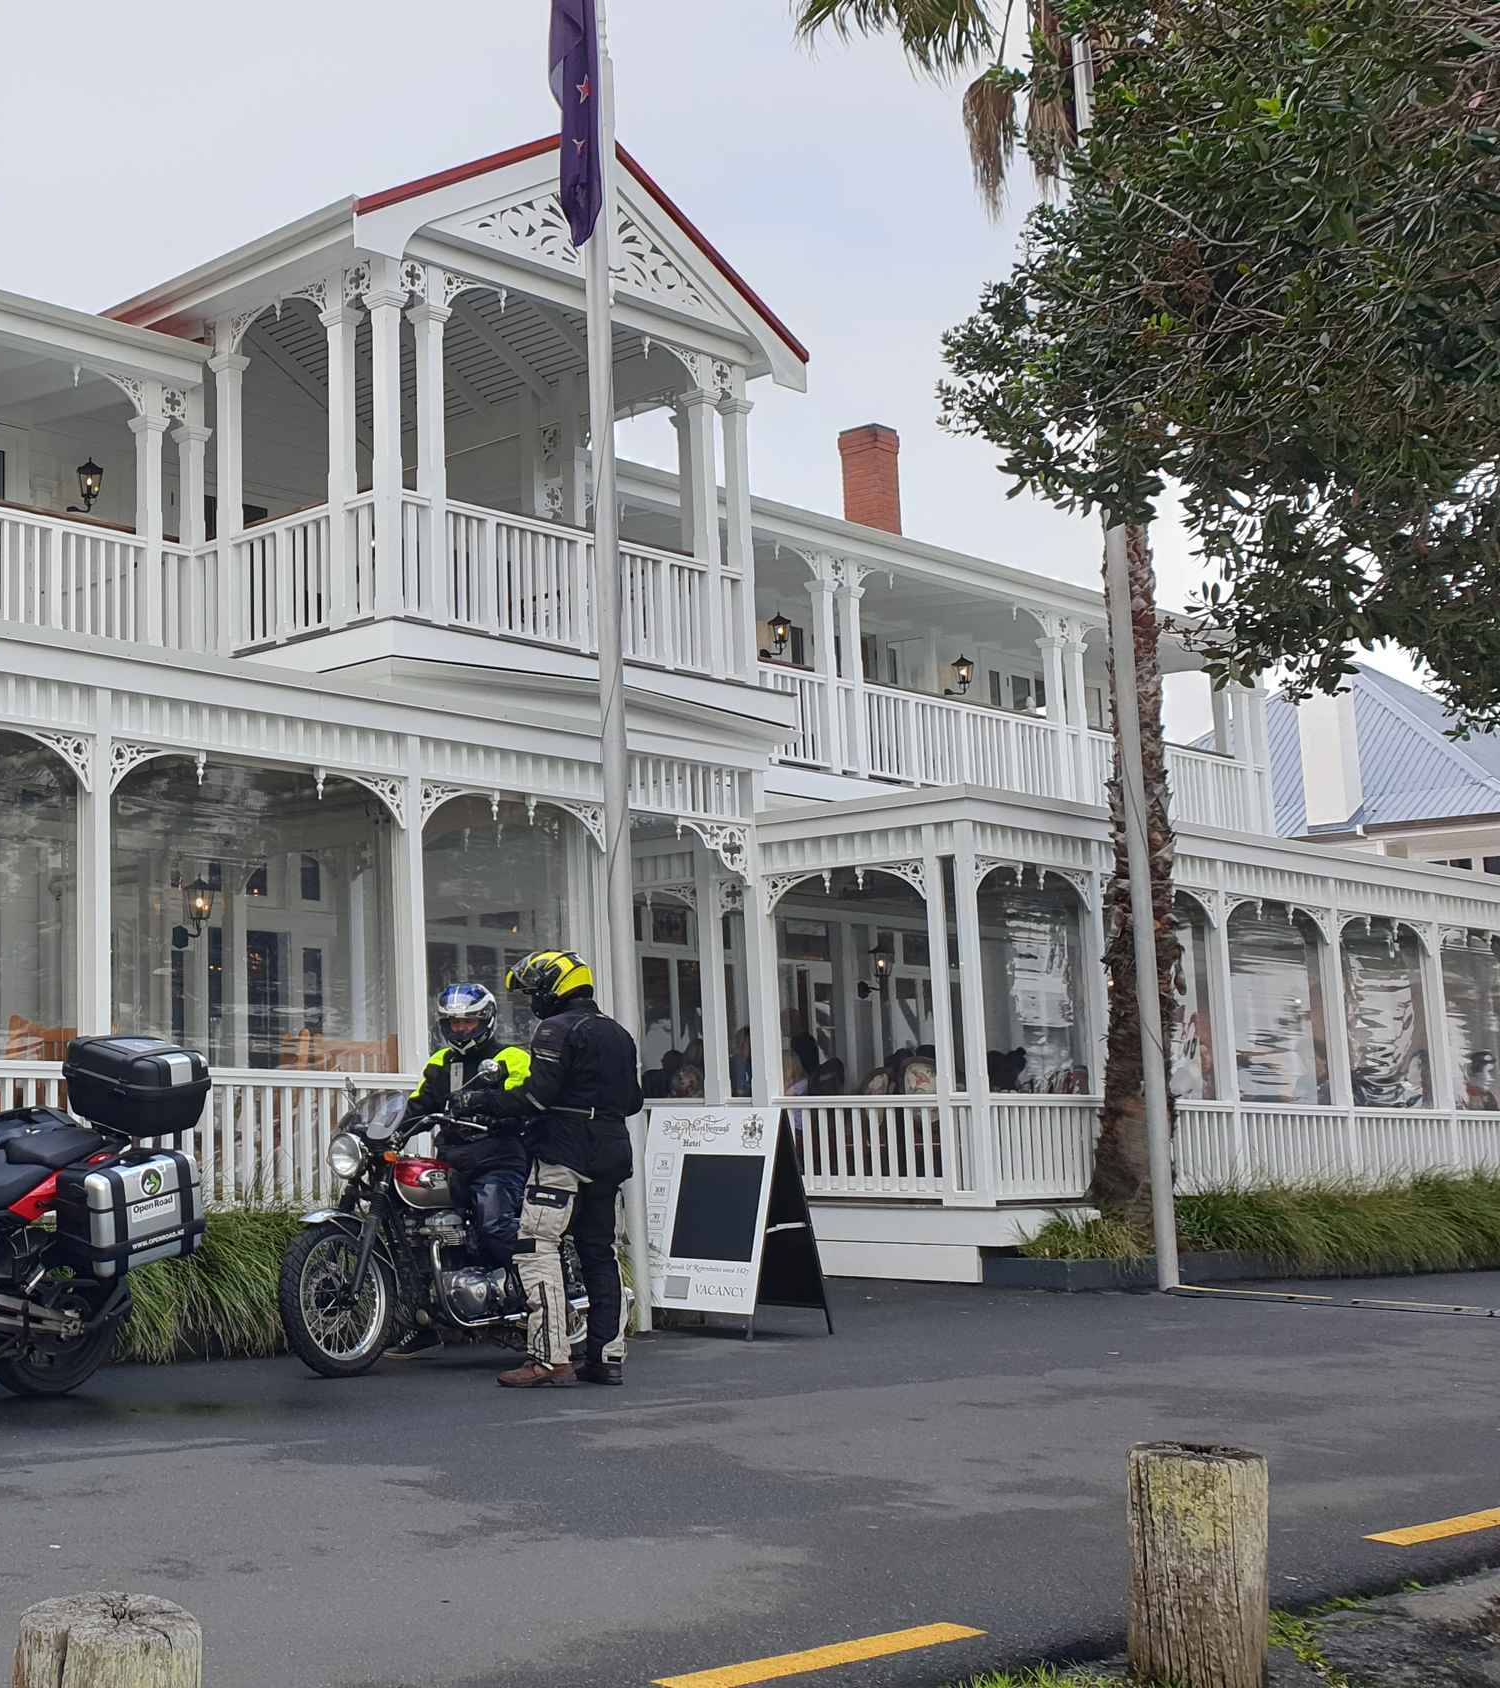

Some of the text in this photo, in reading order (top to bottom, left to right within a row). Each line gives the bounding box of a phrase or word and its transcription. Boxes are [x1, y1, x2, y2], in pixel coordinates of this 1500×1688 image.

[133, 1195, 172, 1213] Open Road
[695, 1283, 747, 1298] VACANCY
